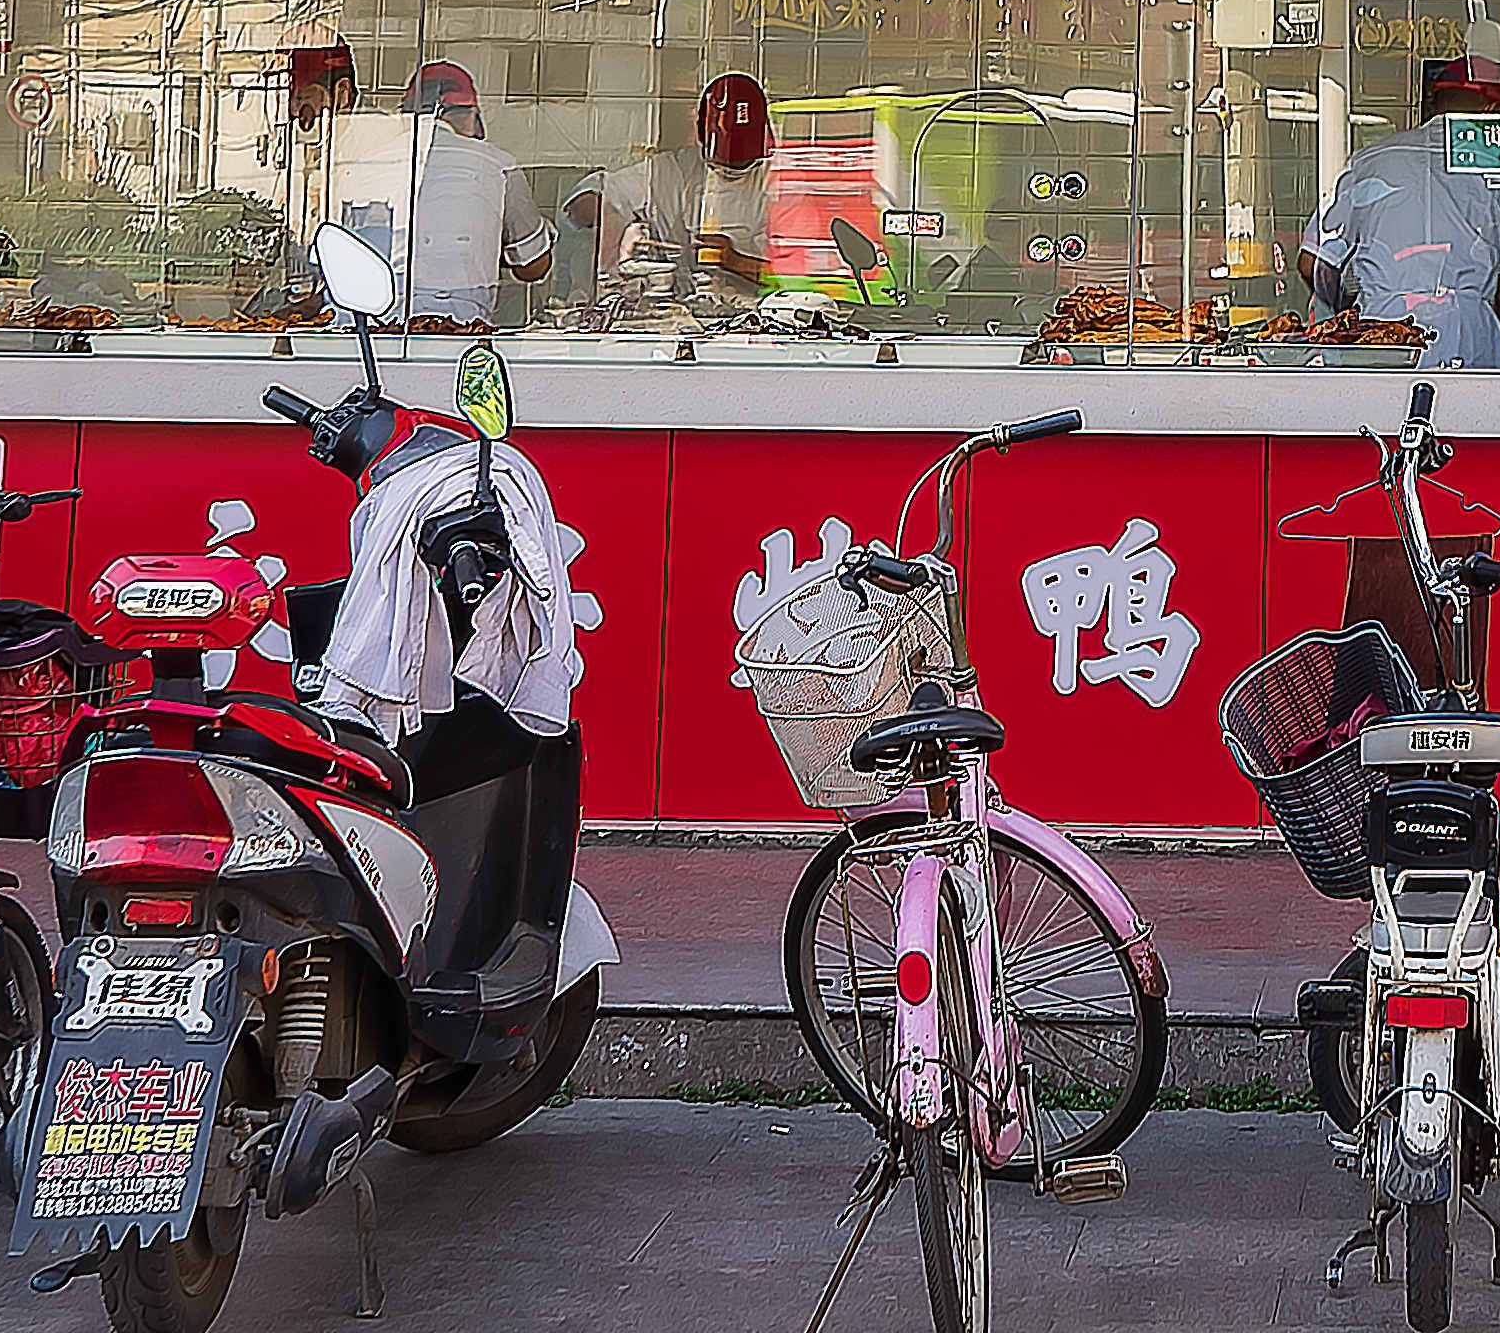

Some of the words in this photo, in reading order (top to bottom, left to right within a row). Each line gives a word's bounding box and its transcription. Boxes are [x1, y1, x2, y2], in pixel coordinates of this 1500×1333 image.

[55, 1058, 212, 1124] 俊杰车业
[42, 1124, 200, 1156] 精品电动车专卖
